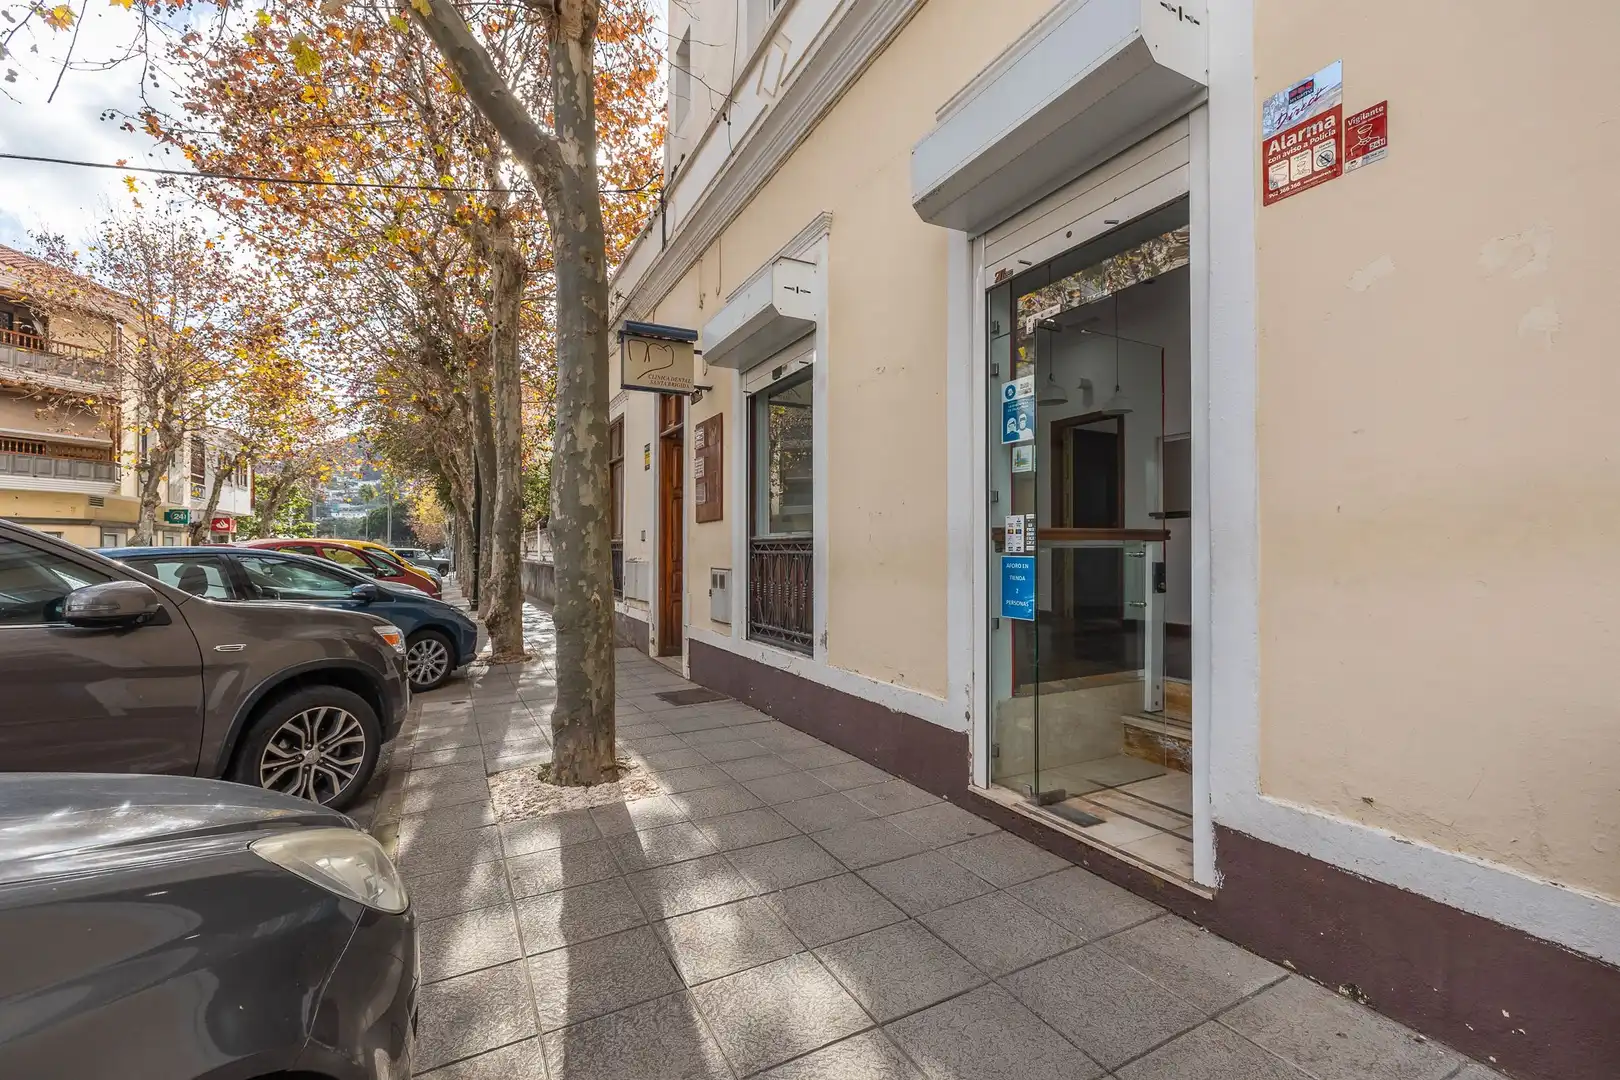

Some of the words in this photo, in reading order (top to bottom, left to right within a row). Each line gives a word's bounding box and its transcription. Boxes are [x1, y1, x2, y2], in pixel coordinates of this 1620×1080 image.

[1347, 106, 1384, 126] Vigilante
[1268, 115, 1335, 156] Alarma
[1268, 154, 1281, 164] con
[1282, 145, 1302, 158] aviso
